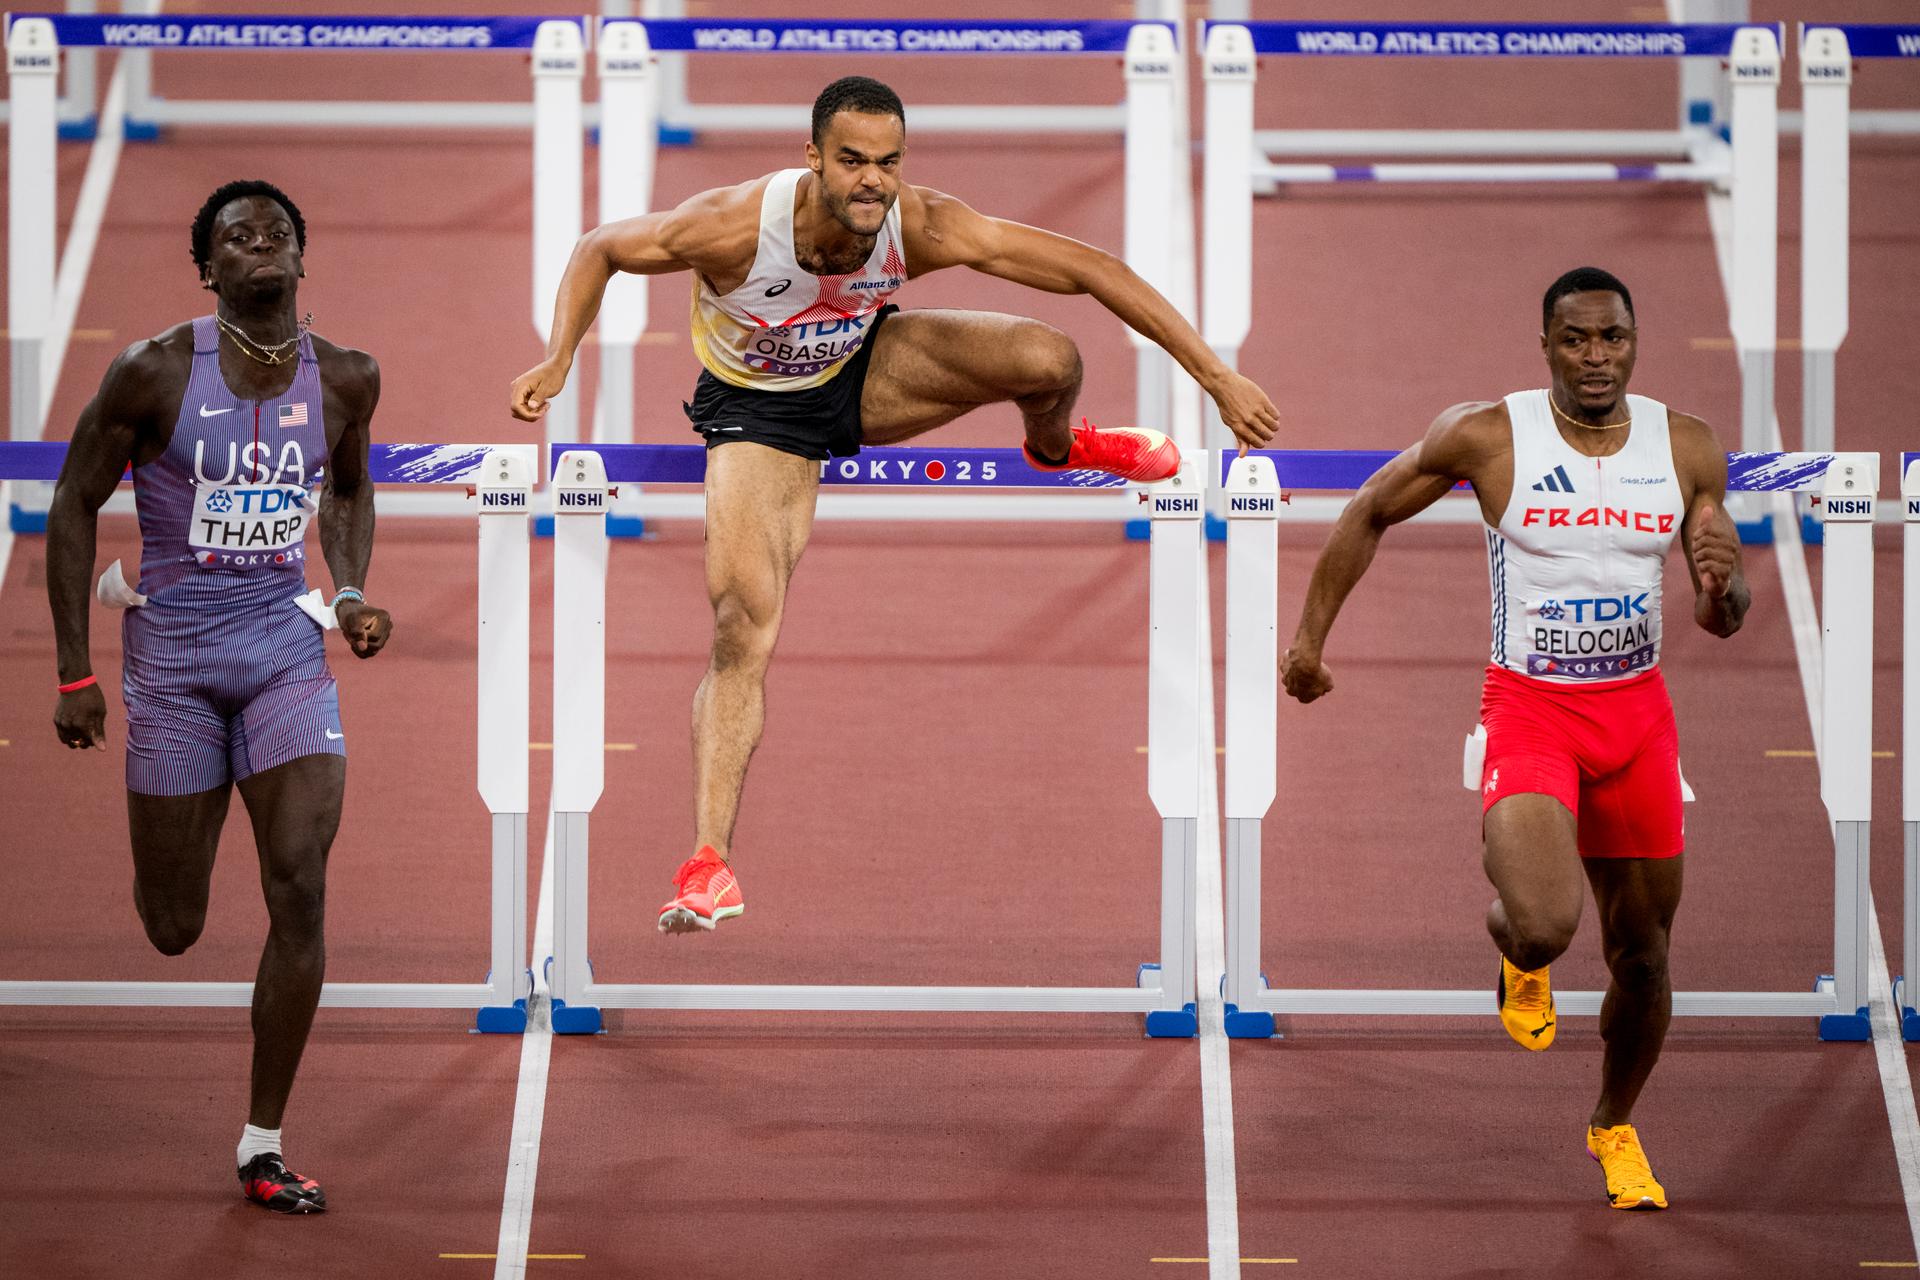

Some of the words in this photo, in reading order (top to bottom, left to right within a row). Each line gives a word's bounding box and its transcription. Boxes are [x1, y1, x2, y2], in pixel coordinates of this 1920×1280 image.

[102, 25, 183, 45] WORLD
[186, 25, 305, 45] ATHLETICS
[308, 26, 492, 47] CHAMPIONSHIPS
[693, 28, 777, 48] WORLD
[776, 28, 898, 48] ATHLETICS
[901, 29, 1085, 50] CHAMPIONSHIPS
[1296, 32, 1378, 52] WORLD
[1381, 32, 1499, 52] ATHLETICS
[1503, 33, 1687, 54] CHAMPIONSHIPS
[849, 281, 886, 290] Allianz
[791, 315, 865, 340] TDK
[194, 439, 305, 486] USA
[233, 489, 305, 514] TDK
[482, 493, 526, 506] NISHI
[559, 493, 603, 506] NISHI
[1155, 498, 1199, 511] NISHI
[1231, 497, 1274, 511] NISHI
[1828, 500, 1871, 514] NISHI
[200, 515, 302, 547] THARP
[1522, 507, 1675, 534] FRANCE
[1564, 592, 1650, 624] TDK
[1534, 618, 1650, 655] BELOCIAN
